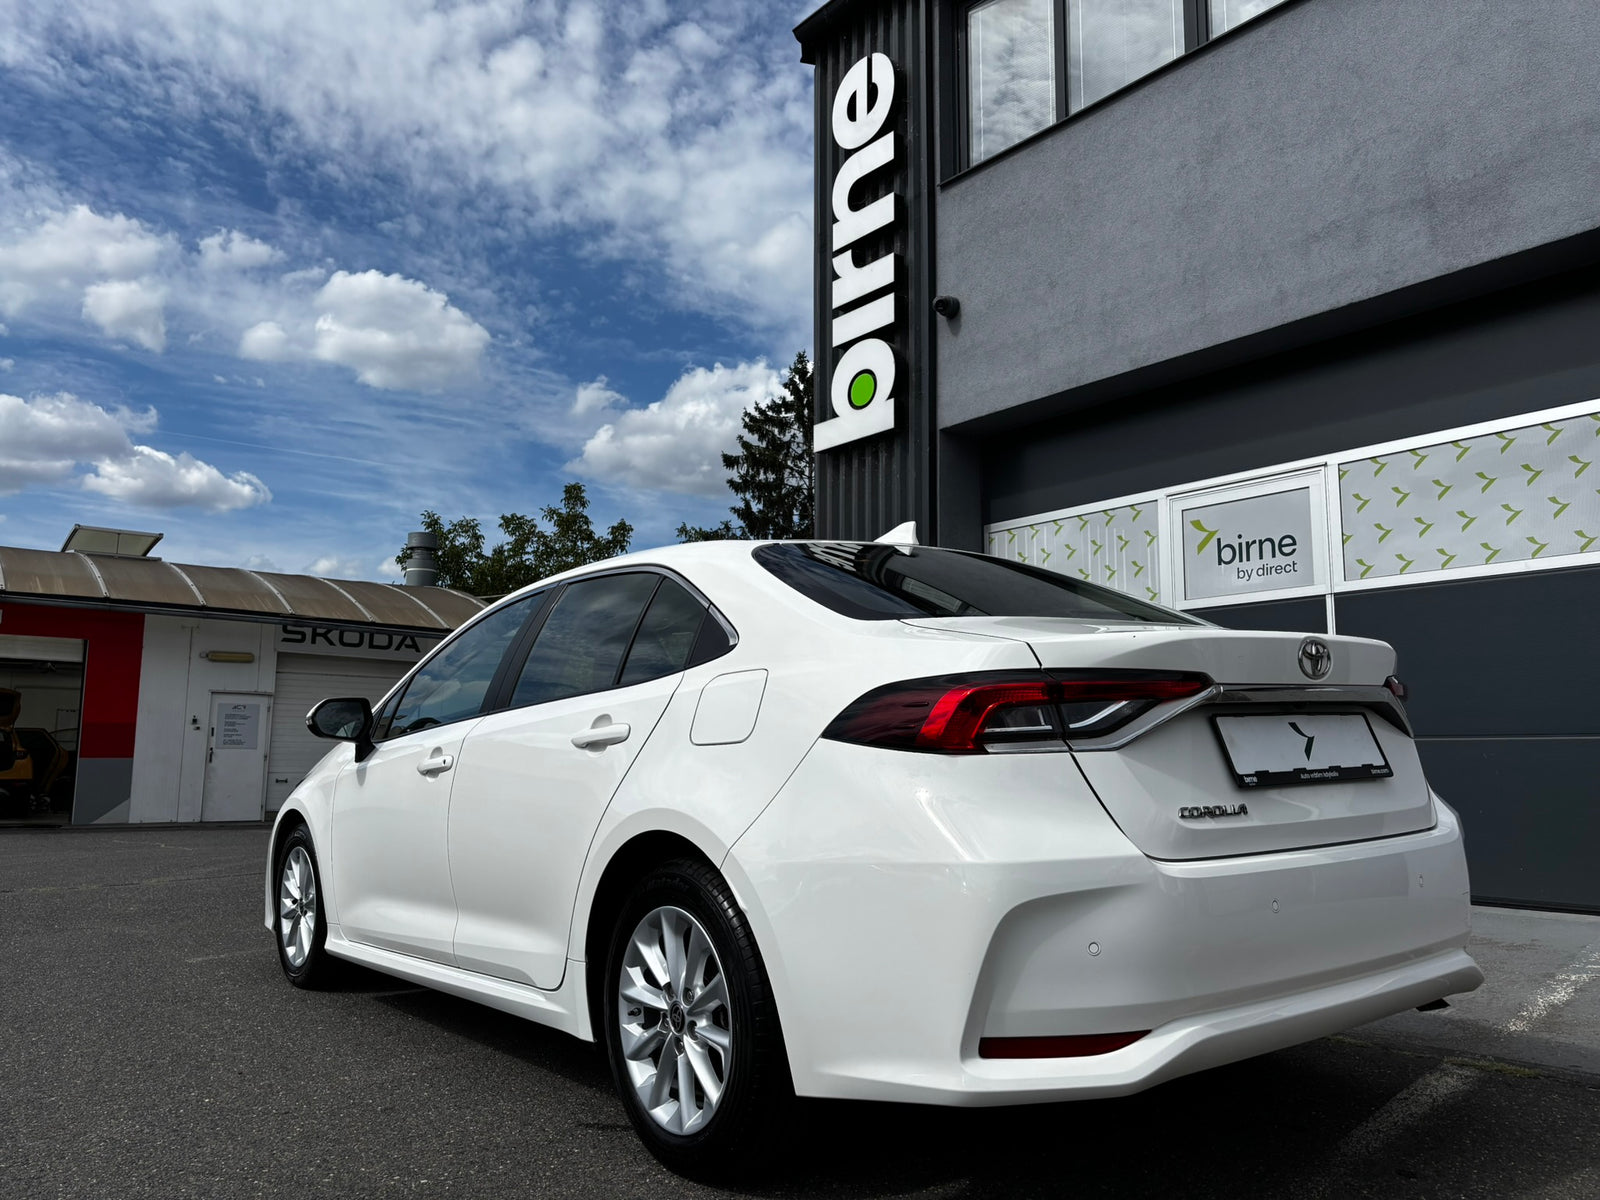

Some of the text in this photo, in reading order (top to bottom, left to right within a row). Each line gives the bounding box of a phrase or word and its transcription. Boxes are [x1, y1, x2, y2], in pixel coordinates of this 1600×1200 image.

[814, 52, 895, 453] birne
[1216, 533, 1297, 566] birne
[1237, 560, 1298, 581] by direct
[1178, 803, 1248, 819] COROLLA
